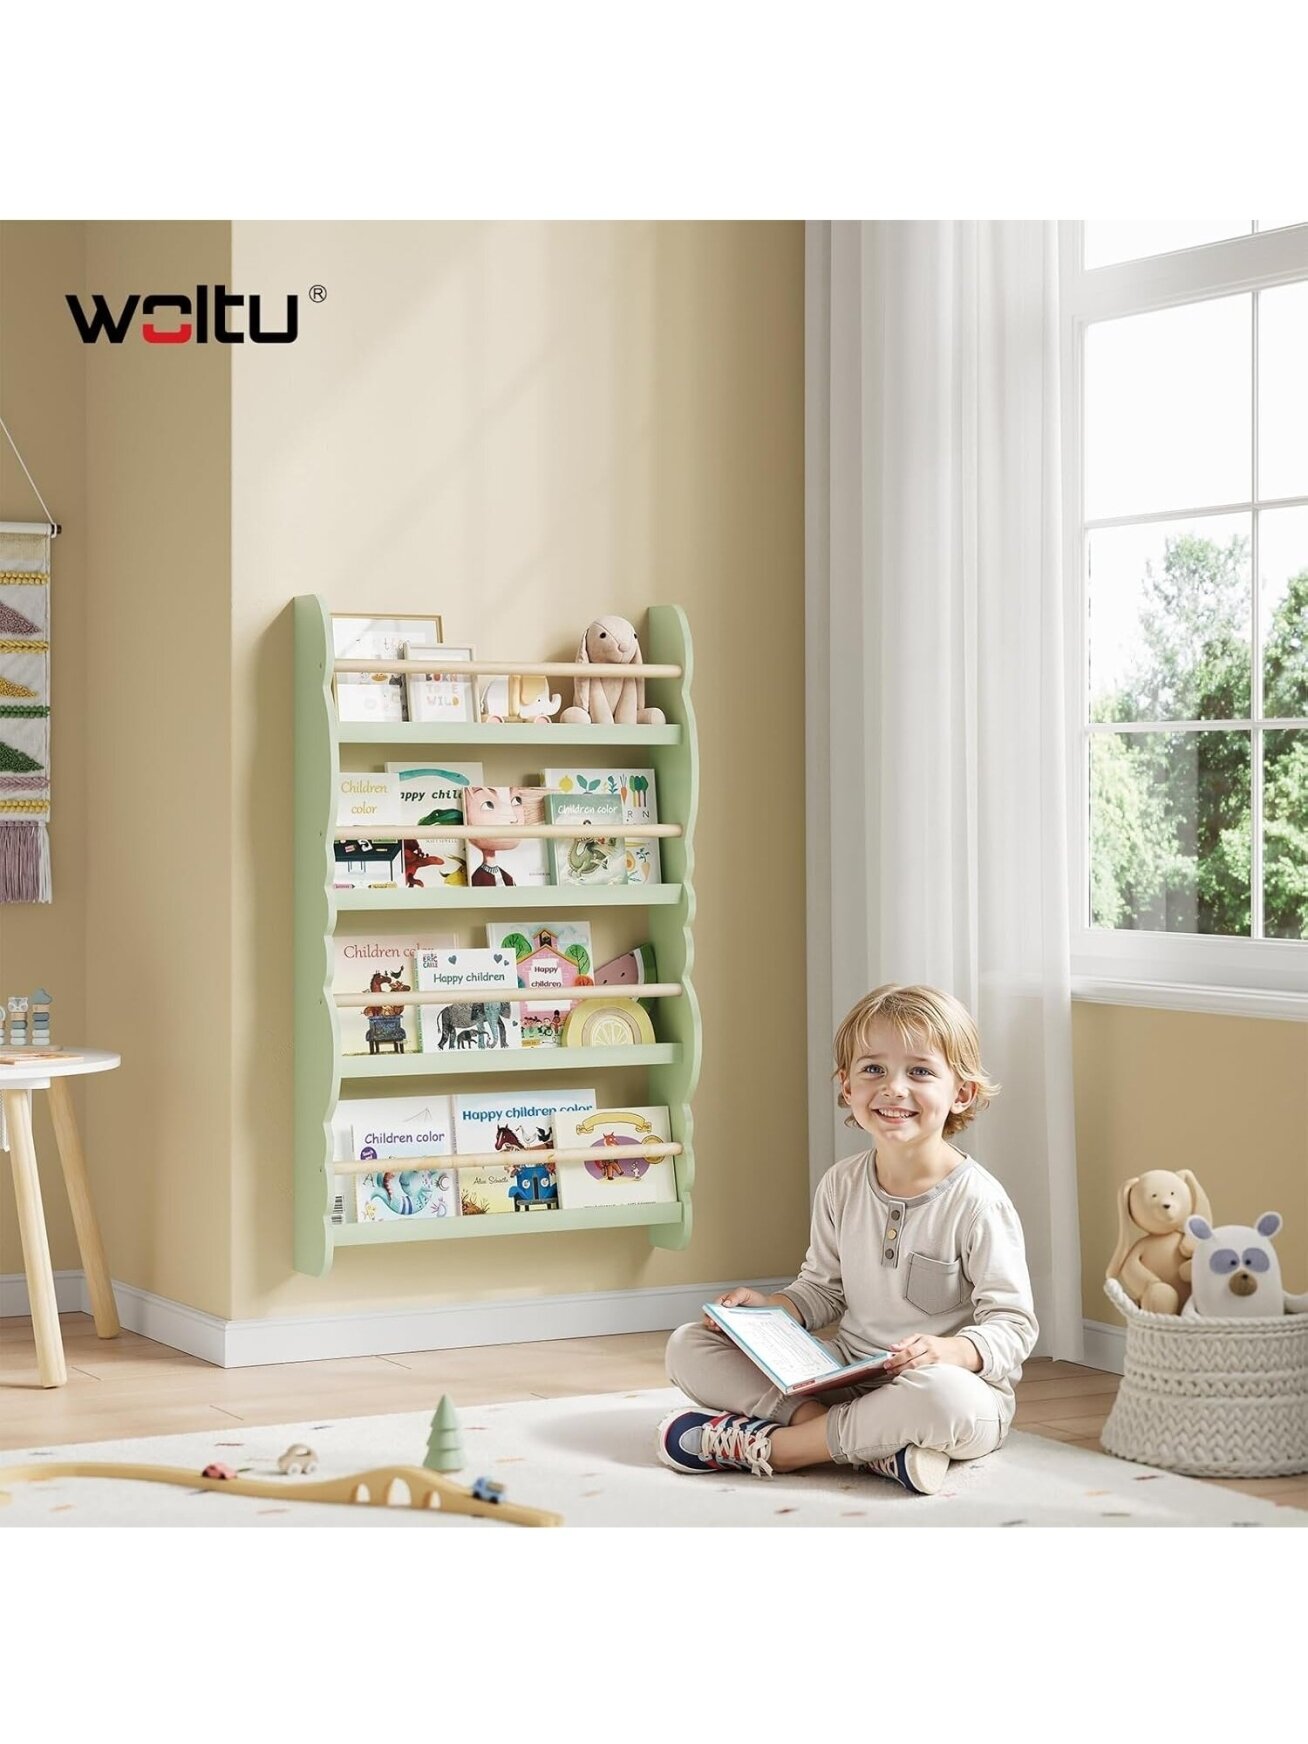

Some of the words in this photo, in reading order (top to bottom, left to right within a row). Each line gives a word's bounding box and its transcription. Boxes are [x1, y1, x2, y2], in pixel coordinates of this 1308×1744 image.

[426, 695, 459, 706] WILD
[341, 780, 387, 794] Children
[351, 801, 378, 814] color
[557, 803, 595, 816] Children
[597, 803, 618, 815] color
[343, 944, 401, 959] Children
[534, 965, 558, 975] Happy
[433, 973, 463, 985] Happy
[465, 972, 505, 982] children
[531, 980, 562, 988] children
[462, 1109, 502, 1122] Happy
[505, 1105, 557, 1120] children
[364, 1132, 413, 1145] Children
[416, 1131, 445, 1143] color
